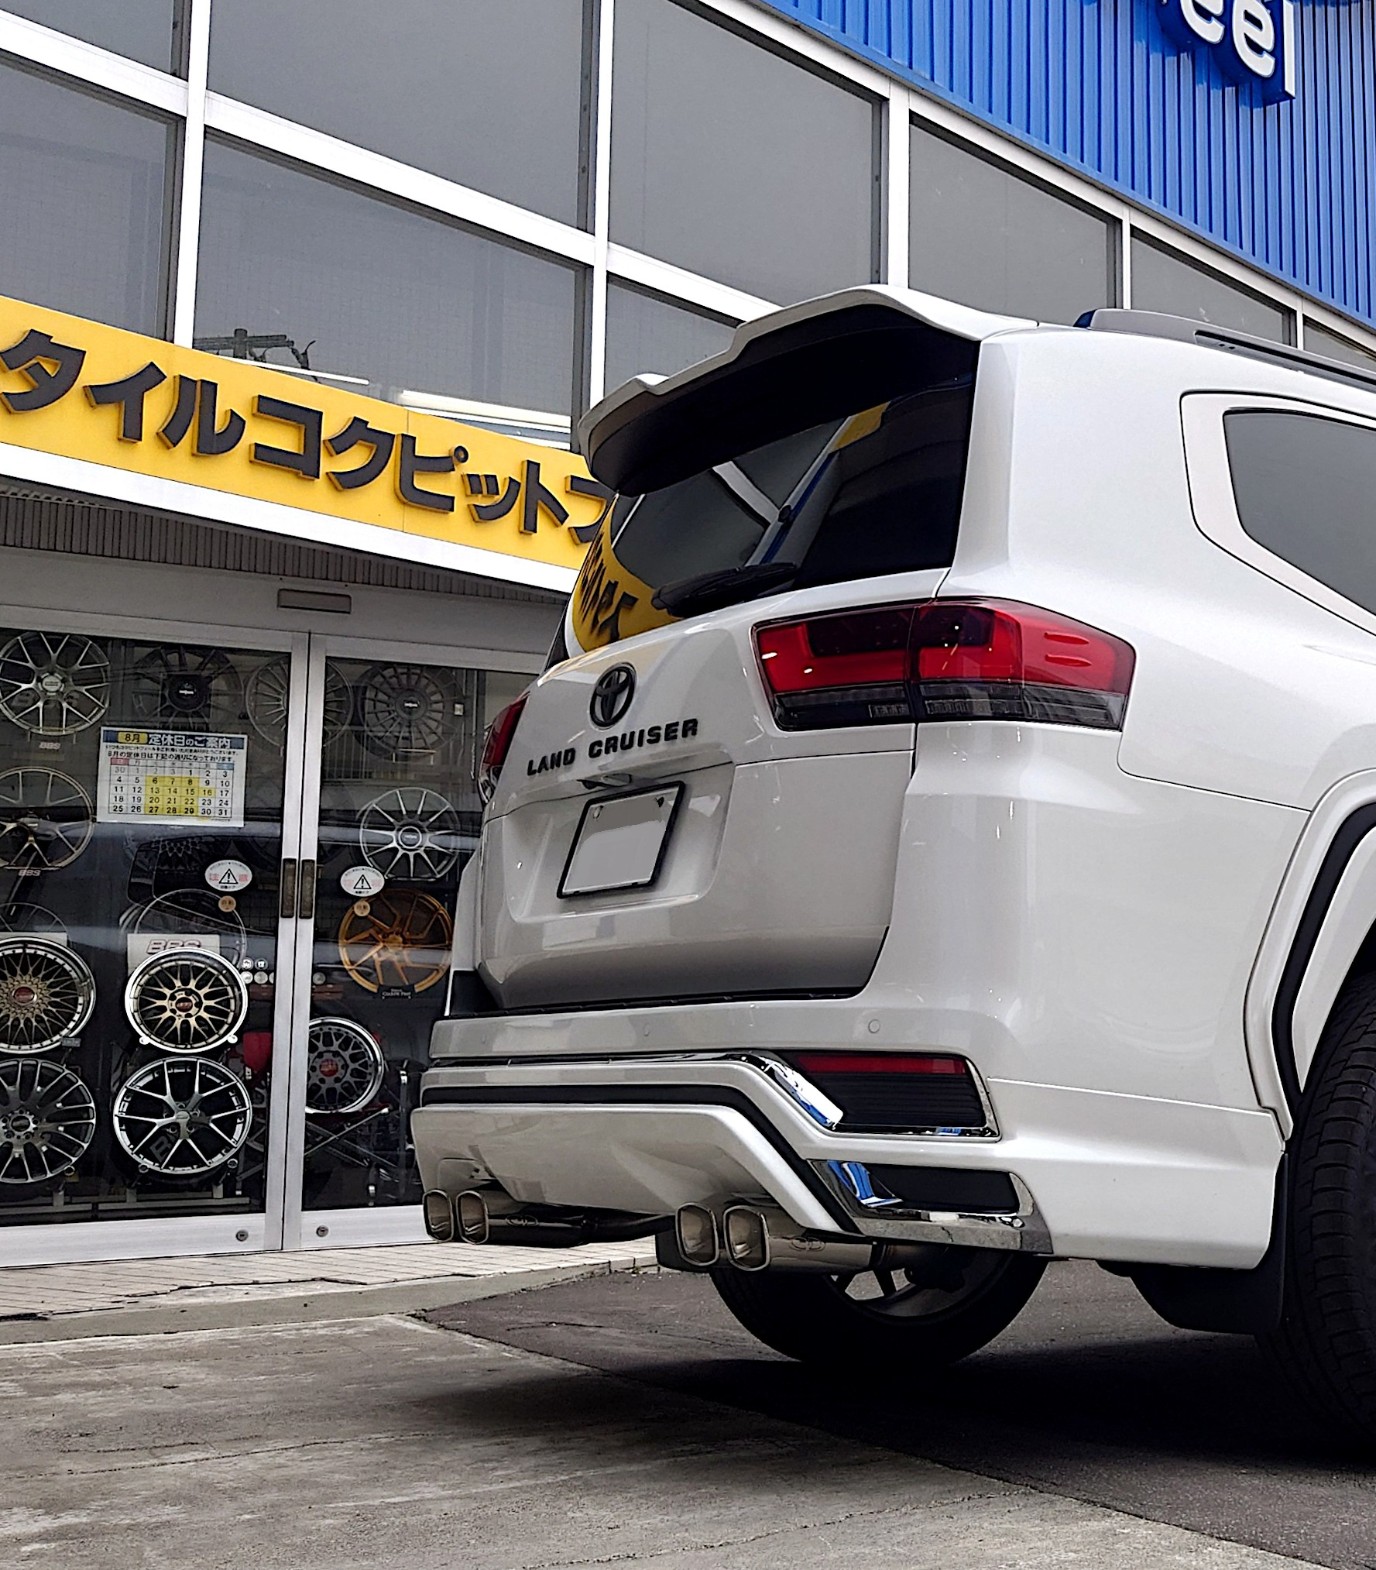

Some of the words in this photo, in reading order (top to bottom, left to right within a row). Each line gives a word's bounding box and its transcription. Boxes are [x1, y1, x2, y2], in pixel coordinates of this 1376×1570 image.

[125, 733, 140, 744] 8月
[148, 733, 231, 749] 定休日のご案内
[527, 748, 576, 776] LAND
[588, 718, 699, 759] CRUISER
